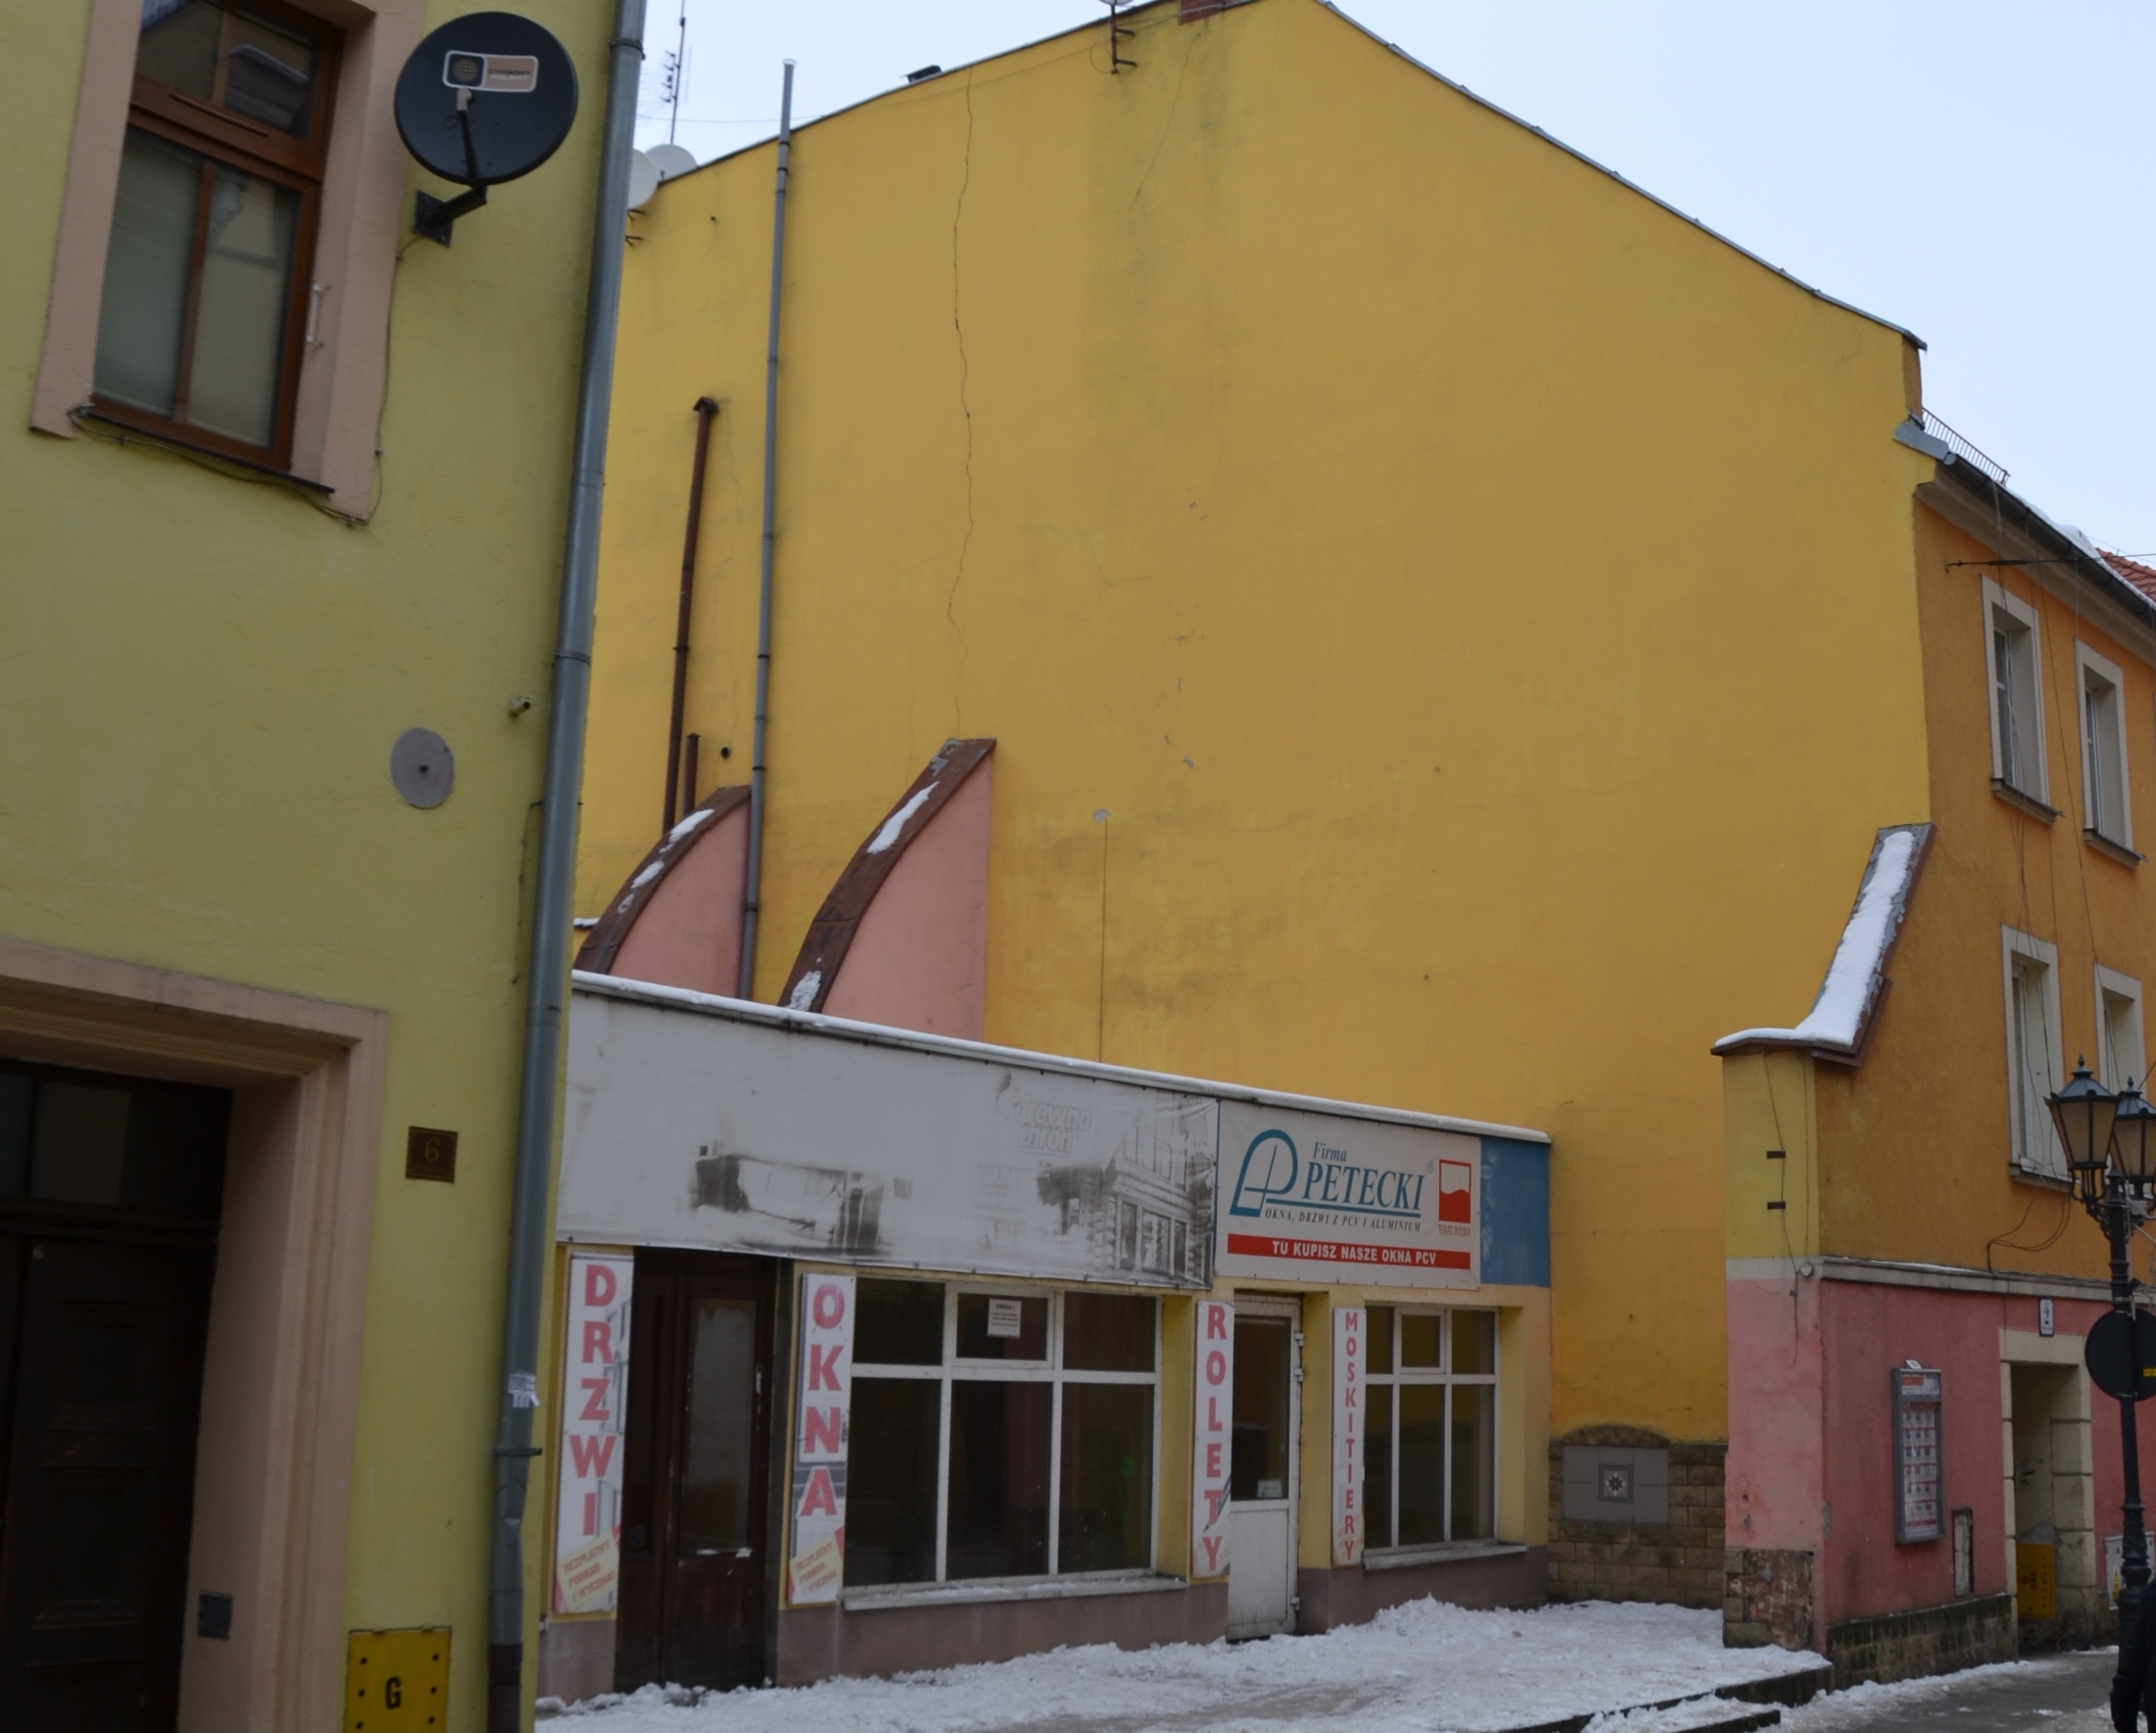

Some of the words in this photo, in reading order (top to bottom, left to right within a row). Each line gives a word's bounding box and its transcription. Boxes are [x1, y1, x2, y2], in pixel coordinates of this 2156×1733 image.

[425, 1138, 439, 1162] 6
[1313, 1142, 1347, 1162] Firma
[1302, 1161, 1425, 1211] PETECKI
[1265, 1208, 1294, 1222] OKNA,
[1299, 1212, 1329, 1225] DRZWI
[1333, 1215, 1338, 1225] Z
[1342, 1215, 1360, 1227] PCV
[1370, 1218, 1421, 1232] ALUMINIUM
[33, 1244, 46, 1260] 6
[1272, 1241, 1288, 1255] TU
[1293, 1242, 1337, 1258] KUPISZ
[1342, 1246, 1377, 1261] NASZE
[1382, 1249, 1411, 1263] OKNA
[1416, 1251, 1436, 1265] PCV
[569, 1264, 617, 1536] DRZWI
[799, 1283, 845, 1516] OKNA
[1202, 1305, 1227, 1571] ROLETY
[1344, 1312, 1358, 1560] MOSKITIERY
[385, 1676, 401, 1711] G
